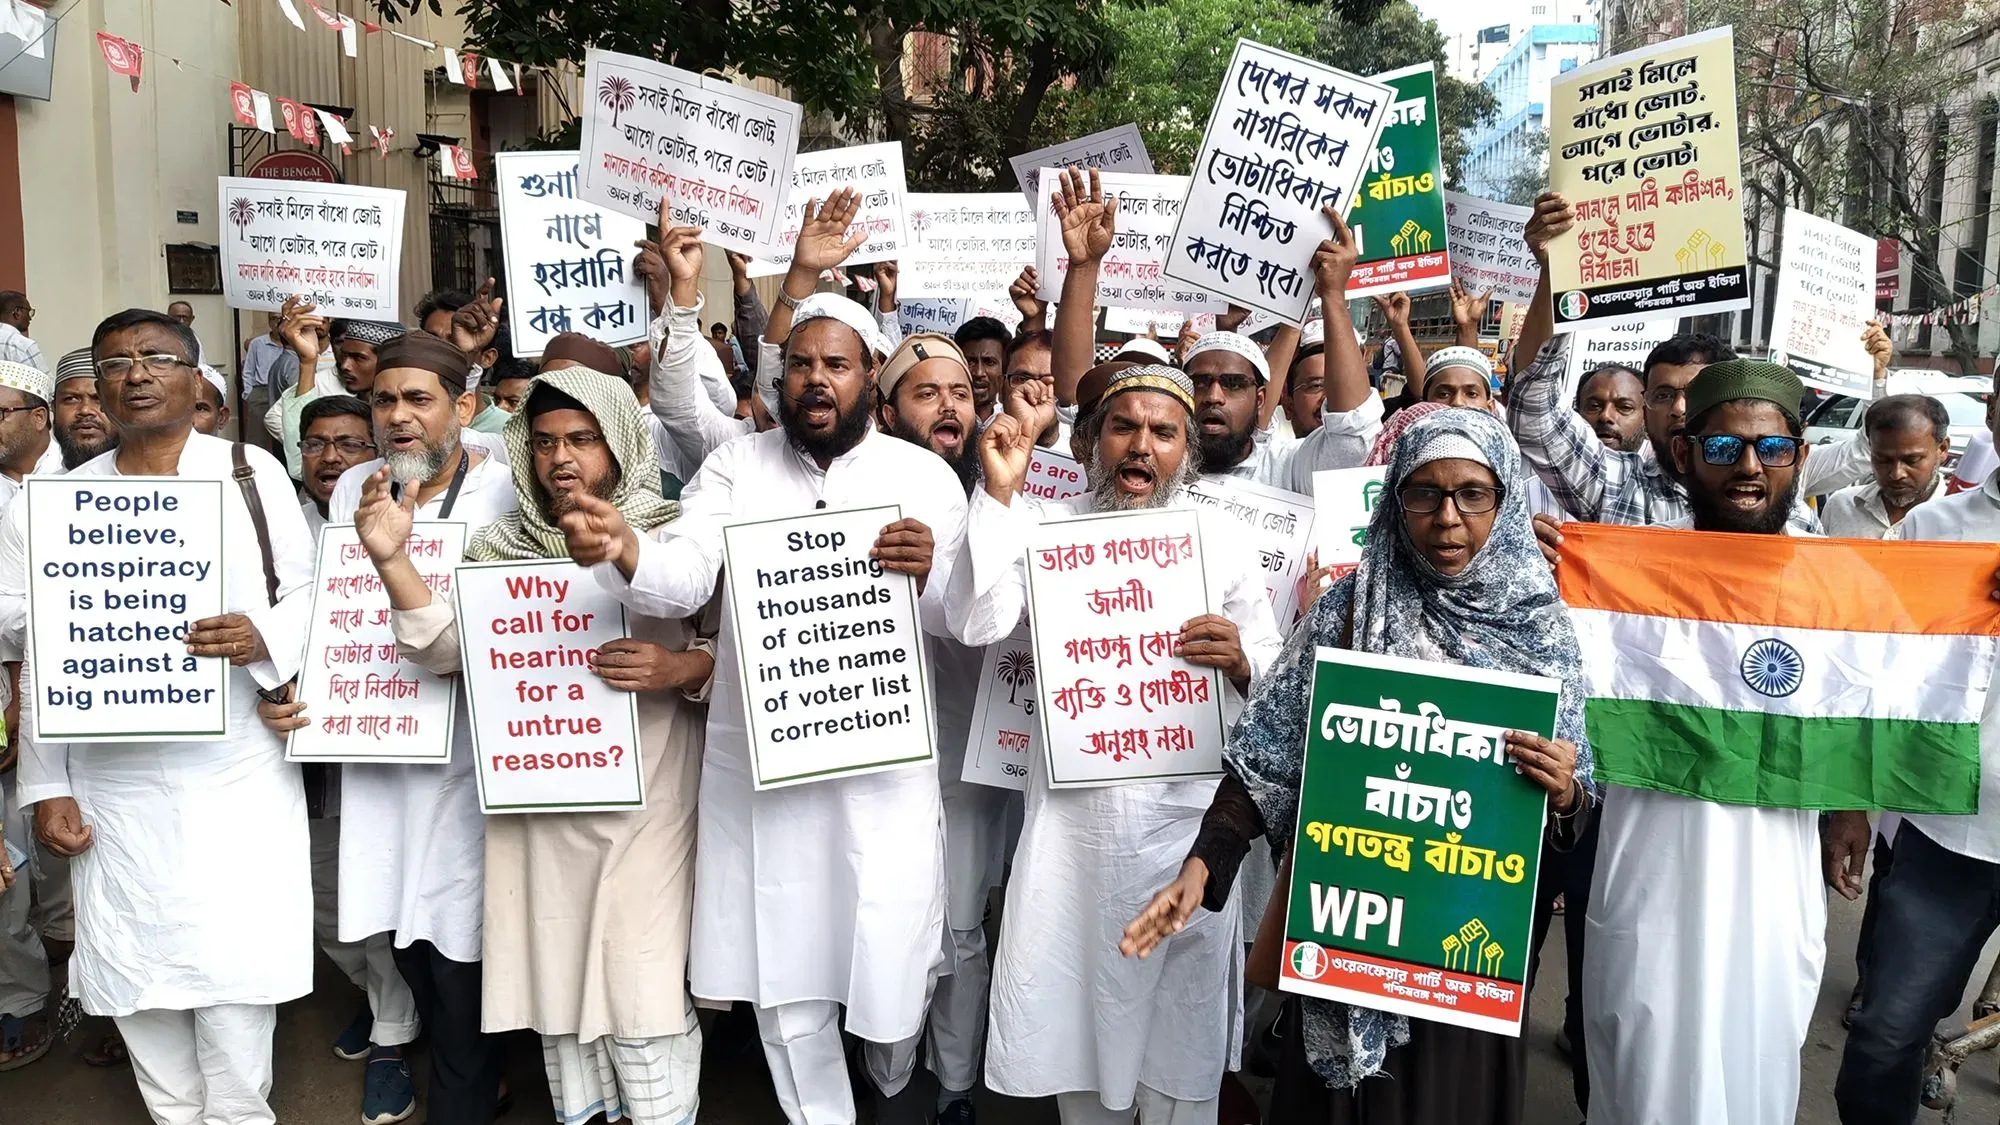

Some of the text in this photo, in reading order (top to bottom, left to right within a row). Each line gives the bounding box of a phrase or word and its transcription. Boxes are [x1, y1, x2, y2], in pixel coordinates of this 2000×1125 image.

[1578, 55, 1699, 102] সবাই মিলে
[1238, 59, 1311, 106] দেশের
[1314, 83, 1378, 128] সকল
[638, 84, 669, 116] সবাই
[671, 88, 702, 123] মিলে
[705, 100, 741, 135] বাঁধো
[1572, 101, 1628, 129] বাঁধো
[623, 123, 655, 149] আগে
[704, 149, 733, 175] পরে
[1232, 107, 1350, 168] নাগরিকের
[1561, 131, 1622, 160] আগে
[260, 167, 322, 177] THE BENGAL
[603, 152, 629, 178] মানলে
[631, 157, 648, 184] দাবি
[680, 177, 706, 204] তবেই
[707, 185, 726, 210] হবে
[1368, 171, 1435, 200] বাঁচাও
[1581, 159, 1627, 185] পরে
[256, 199, 284, 220] সবাই
[287, 197, 314, 221] মিলে
[318, 200, 348, 223] বাঁধো
[1119, 191, 1148, 215] মিলে
[1575, 196, 1621, 226] মানলে
[1625, 176, 1659, 211] দাবি
[544, 213, 603, 249] নামে
[1218, 191, 1298, 245] নিশ্চিত
[249, 235, 275, 253] আগে
[322, 241, 346, 258] পরে
[1467, 232, 1496, 248] হাজার
[1577, 220, 1657, 258] তবেই হবে
[530, 248, 624, 296] হয়রানি
[1185, 235, 1252, 283] করতে
[1460, 246, 1476, 261] নাম
[1478, 249, 1494, 264] বাদ
[1497, 250, 1522, 269] দিলে
[238, 263, 258, 281] মানলে
[260, 259, 274, 281] দাবি
[305, 265, 328, 284] তবেই
[329, 268, 345, 288] হবে
[1656, 279, 1681, 297] পার্টি
[1683, 277, 1706, 291] অফ
[1171, 290, 1208, 305] জনতা
[526, 305, 572, 334] বন্ধ
[903, 302, 936, 322] তালিকা
[938, 307, 957, 326] দিয়ে
[1047, 466, 1079, 482] are
[75, 490, 178, 517] People
[68, 523, 185, 548] believe,
[786, 530, 846, 552] Stop
[1036, 533, 1193, 572] ভারত গণতন্ত্রের
[43, 557, 211, 583] conspiracy
[756, 557, 884, 589] harassing
[69, 589, 187, 614] is being
[505, 575, 569, 604] Why
[756, 584, 892, 620] thousands
[1085, 578, 1153, 617] জননী।
[69, 621, 189, 643] hatched
[329, 608, 364, 633] মাঝে
[491, 609, 594, 635] call for
[762, 617, 896, 650] of citizens
[62, 652, 198, 679] against a
[324, 640, 373, 669] ভোটার
[758, 648, 907, 683] in the name
[1063, 634, 1132, 669] গণতন্ত্র
[47, 684, 215, 711] big number
[329, 668, 420, 704] দিয়ে নির্বাচন
[516, 680, 584, 703] for a
[763, 673, 912, 713] of voter list
[1051, 670, 1210, 720] ব্যক্তি ও গোষ্ঠীর
[322, 715, 352, 736] করা
[357, 715, 391, 741] যাবে
[507, 714, 602, 737] untrue
[770, 703, 912, 743] correction!
[491, 745, 624, 772] reasons?
[1079, 729, 1152, 762] অনুগ্রহ
[1365, 761, 1473, 831] বাঁচাও
[1304, 821, 1527, 884] গণতন্ত্র বাঁচাও
[1309, 881, 1406, 948] WPI
[1330, 955, 1515, 1004] ওয়েলফেয়ার পার্টি অফ ইন্ডিয়া
[1432, 989, 1458, 1006] শাখা
